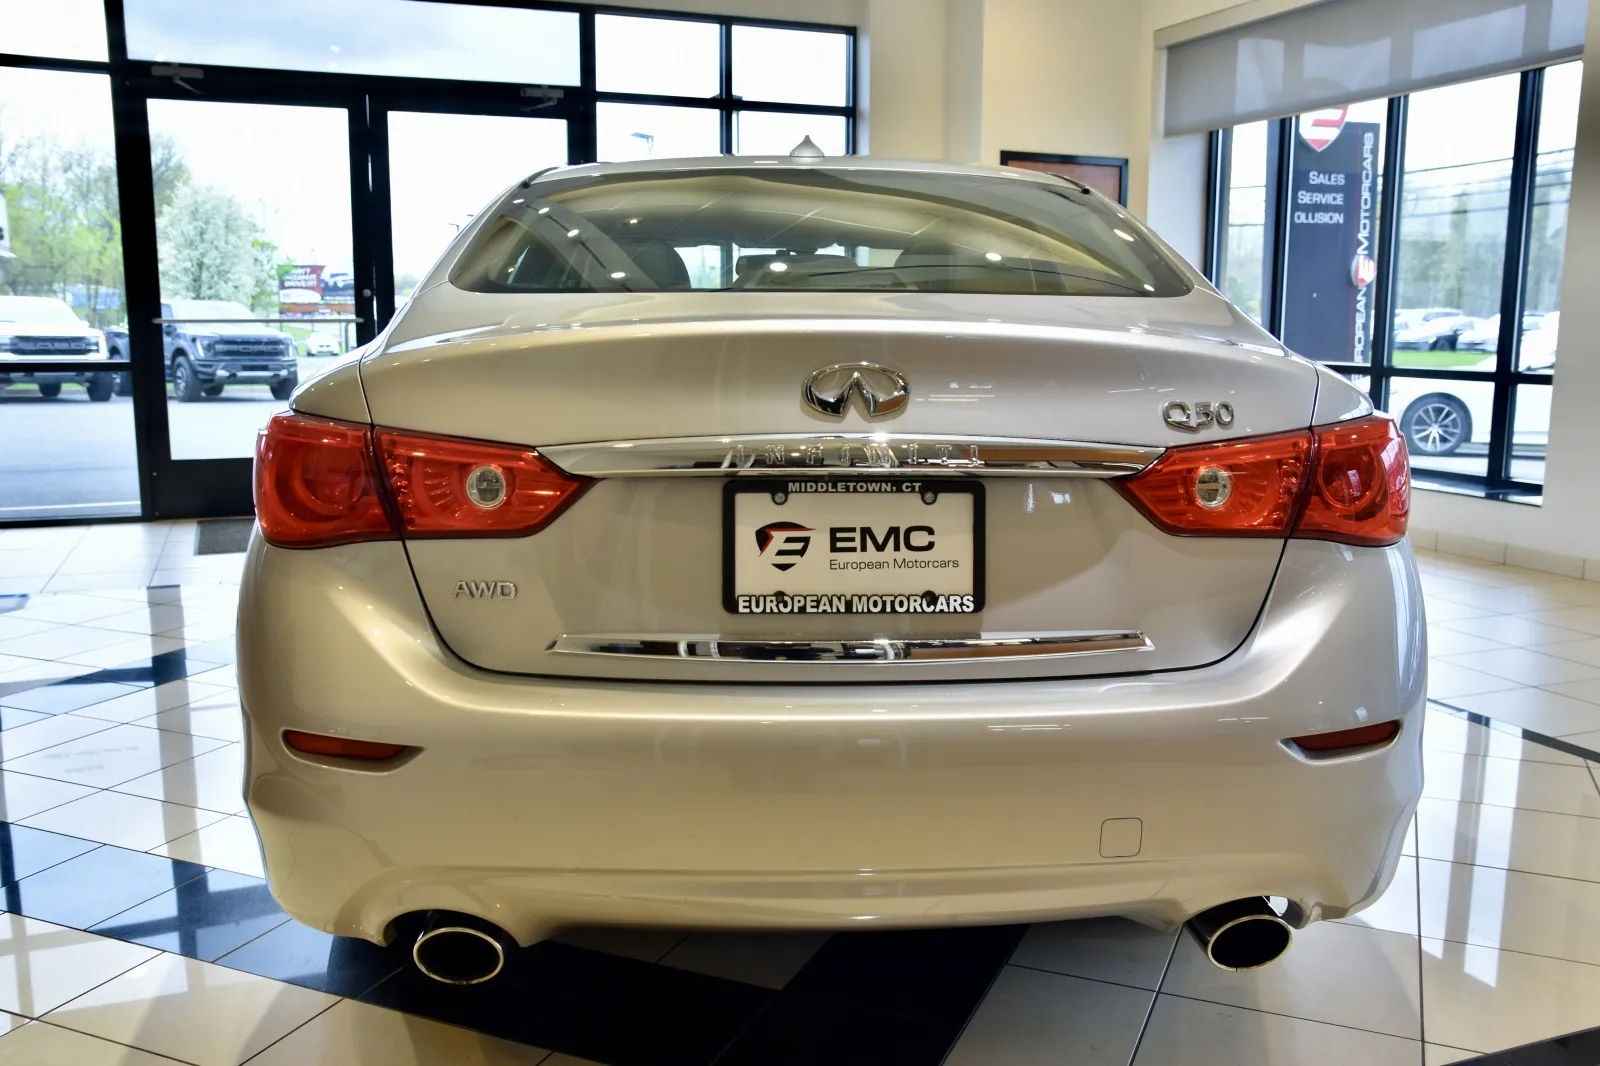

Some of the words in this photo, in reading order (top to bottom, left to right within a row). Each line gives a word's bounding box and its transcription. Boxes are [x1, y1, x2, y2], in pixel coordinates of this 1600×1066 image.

[1309, 171, 1345, 185] SALES
[1297, 190, 1344, 205] SERVICE
[1356, 132, 1375, 255] MOTORCARS
[1351, 286, 1367, 382] ROPEAN
[1163, 400, 1235, 432] Q50
[787, 482, 897, 493] MIDDLETOWN,
[901, 482, 922, 492] CT
[829, 525, 935, 552] EMC
[829, 559, 890, 572] European
[893, 557, 960, 570] Motorcars
[452, 580, 518, 599] AWD
[738, 595, 846, 613] EUROPEAN
[852, 595, 975, 613] MOTORCARS
